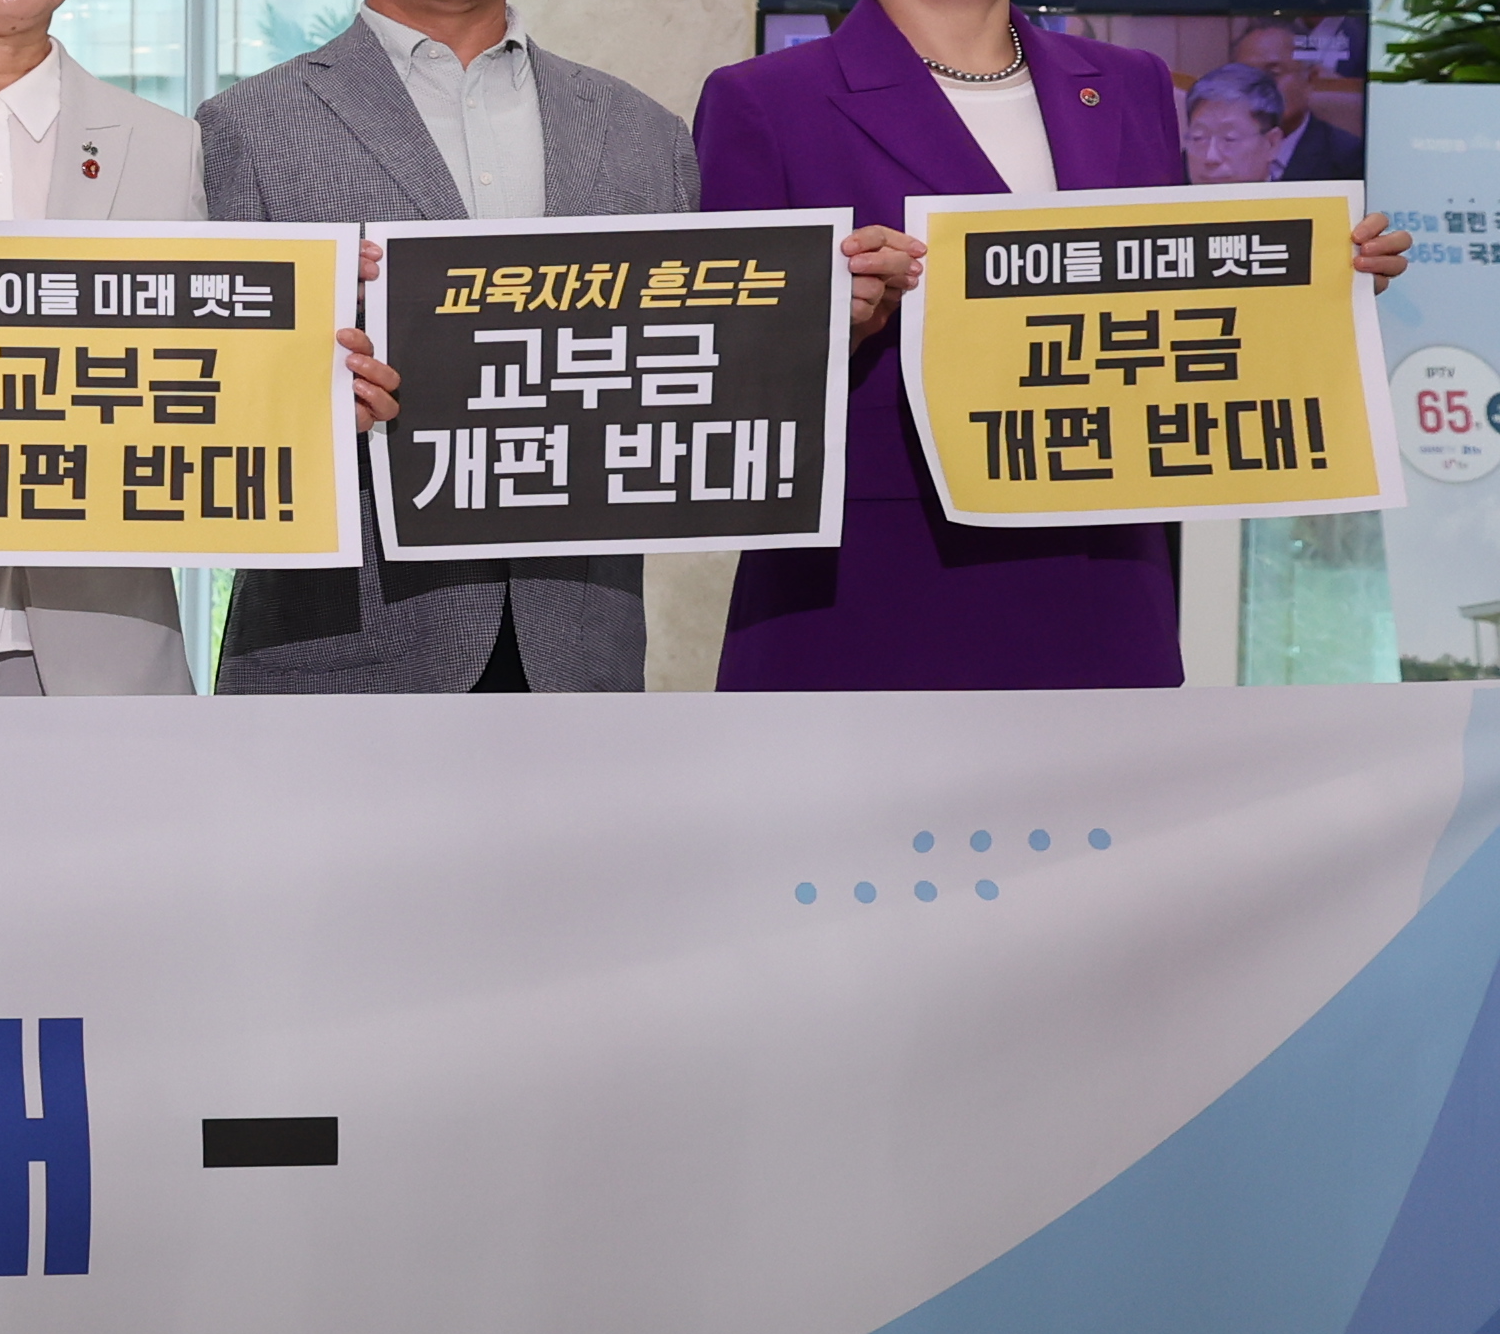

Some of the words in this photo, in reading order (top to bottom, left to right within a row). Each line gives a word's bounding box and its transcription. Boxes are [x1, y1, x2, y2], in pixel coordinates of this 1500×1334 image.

[94, 273, 175, 316] 미래
[190, 274, 273, 317] 뺏는
[435, 262, 630, 314] 교육자치
[639, 259, 786, 309] 흔드는
[985, 241, 1103, 286] 아이들
[1116, 236, 1195, 280] 미래
[1208, 234, 1289, 277] 뺏는
[467, 323, 720, 410] 교부금
[1018, 306, 1242, 388] 교부금
[412, 424, 569, 510] 개편
[604, 419, 797, 504] 반대!
[968, 406, 1114, 482] 개편
[1146, 397, 1328, 478] 반대!
[122, 445, 294, 522] 반대!
